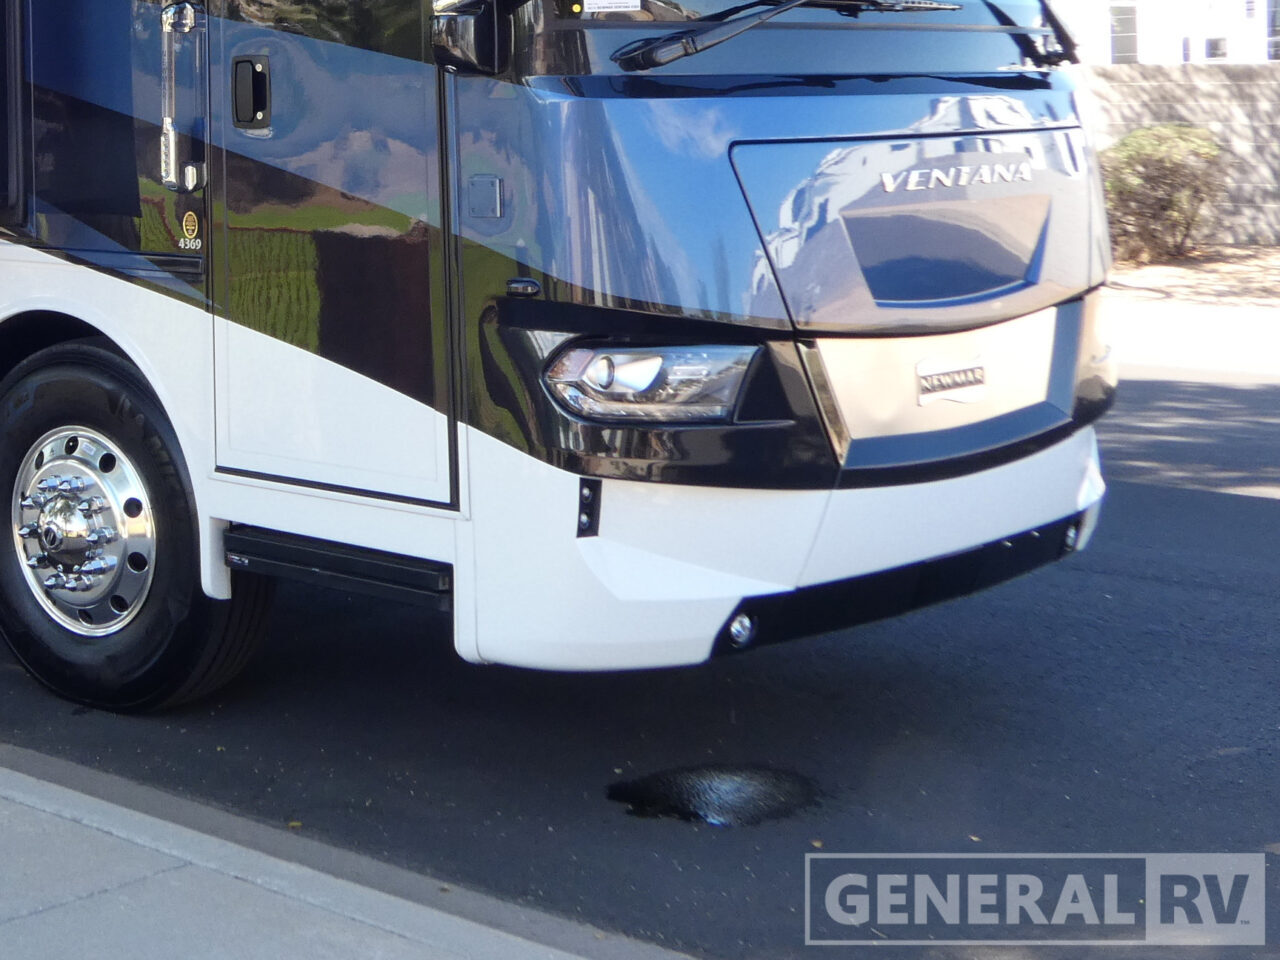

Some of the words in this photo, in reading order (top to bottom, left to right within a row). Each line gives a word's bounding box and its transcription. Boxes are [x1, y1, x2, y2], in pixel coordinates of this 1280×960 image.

[880, 161, 1033, 193] VENTANA
[178, 237, 202, 250] 4369
[920, 367, 984, 393] NEWMAR
